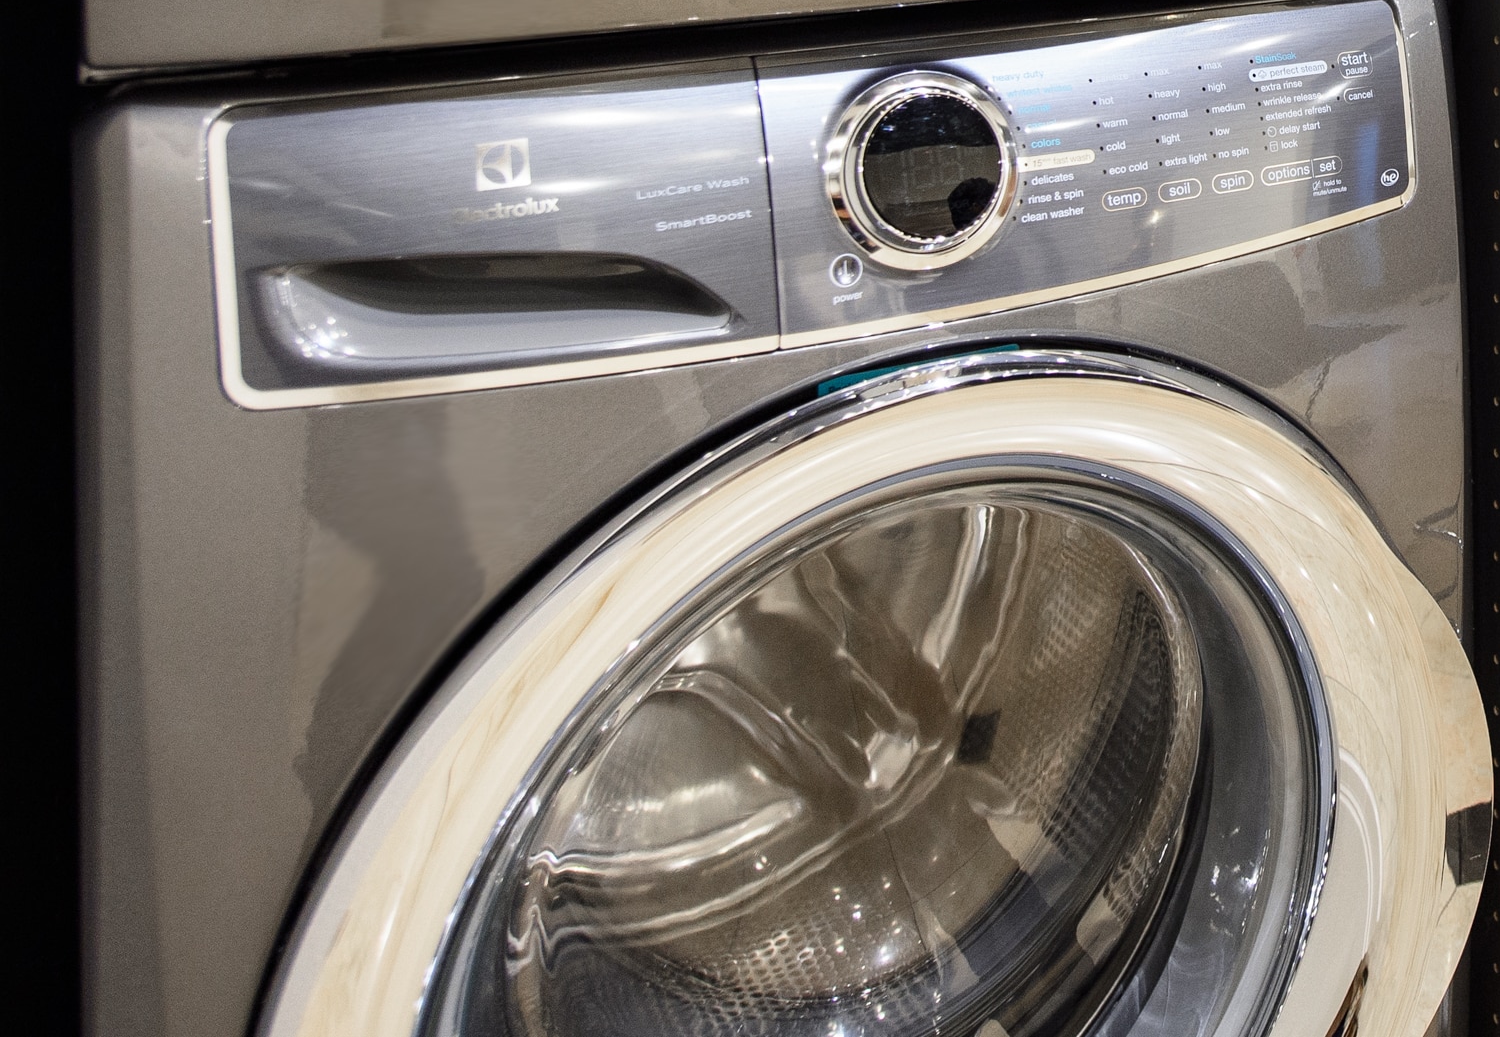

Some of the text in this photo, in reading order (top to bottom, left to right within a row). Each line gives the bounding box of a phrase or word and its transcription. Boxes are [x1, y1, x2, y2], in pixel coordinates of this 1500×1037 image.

[1255, 52, 1297, 64] StainSoak
[1341, 52, 1368, 67] start
[1151, 68, 1170, 77] max
[1204, 61, 1222, 70] max
[1270, 63, 1325, 79] perfect steam
[1345, 66, 1369, 77] pause
[1208, 82, 1227, 93] high
[1260, 79, 1303, 93] extra rinse
[1154, 88, 1181, 99] heavy
[1263, 92, 1322, 107] wrinkle release
[1348, 89, 1374, 102] cancel
[1099, 96, 1115, 106] hot
[1211, 102, 1246, 114] medium
[1158, 108, 1189, 122] normal
[1265, 104, 1332, 122] extended refresh
[1102, 118, 1129, 129] warm
[1279, 120, 1321, 136] delay start
[1214, 126, 1230, 136] low
[1031, 137, 1062, 149] colors
[1106, 140, 1127, 152] cold
[1161, 133, 1181, 146] light
[1280, 139, 1299, 149] lock
[1165, 152, 1208, 167] extra light
[1218, 146, 1250, 159] no spin
[1109, 161, 1149, 176] eco cold
[1267, 159, 1337, 181] options set
[1031, 172, 1075, 186] delicates
[1220, 175, 1246, 190] spin
[1323, 178, 1343, 187] hold to
[636, 176, 750, 201] LuxCare Wash
[1168, 182, 1191, 197] soil
[1312, 186, 1348, 197] mute/unmute
[1028, 188, 1085, 205] rinse & spin
[1107, 192, 1143, 207] temp
[655, 207, 753, 233] SmartBoost
[1021, 206, 1086, 224] clean washer
[832, 289, 864, 306] power
